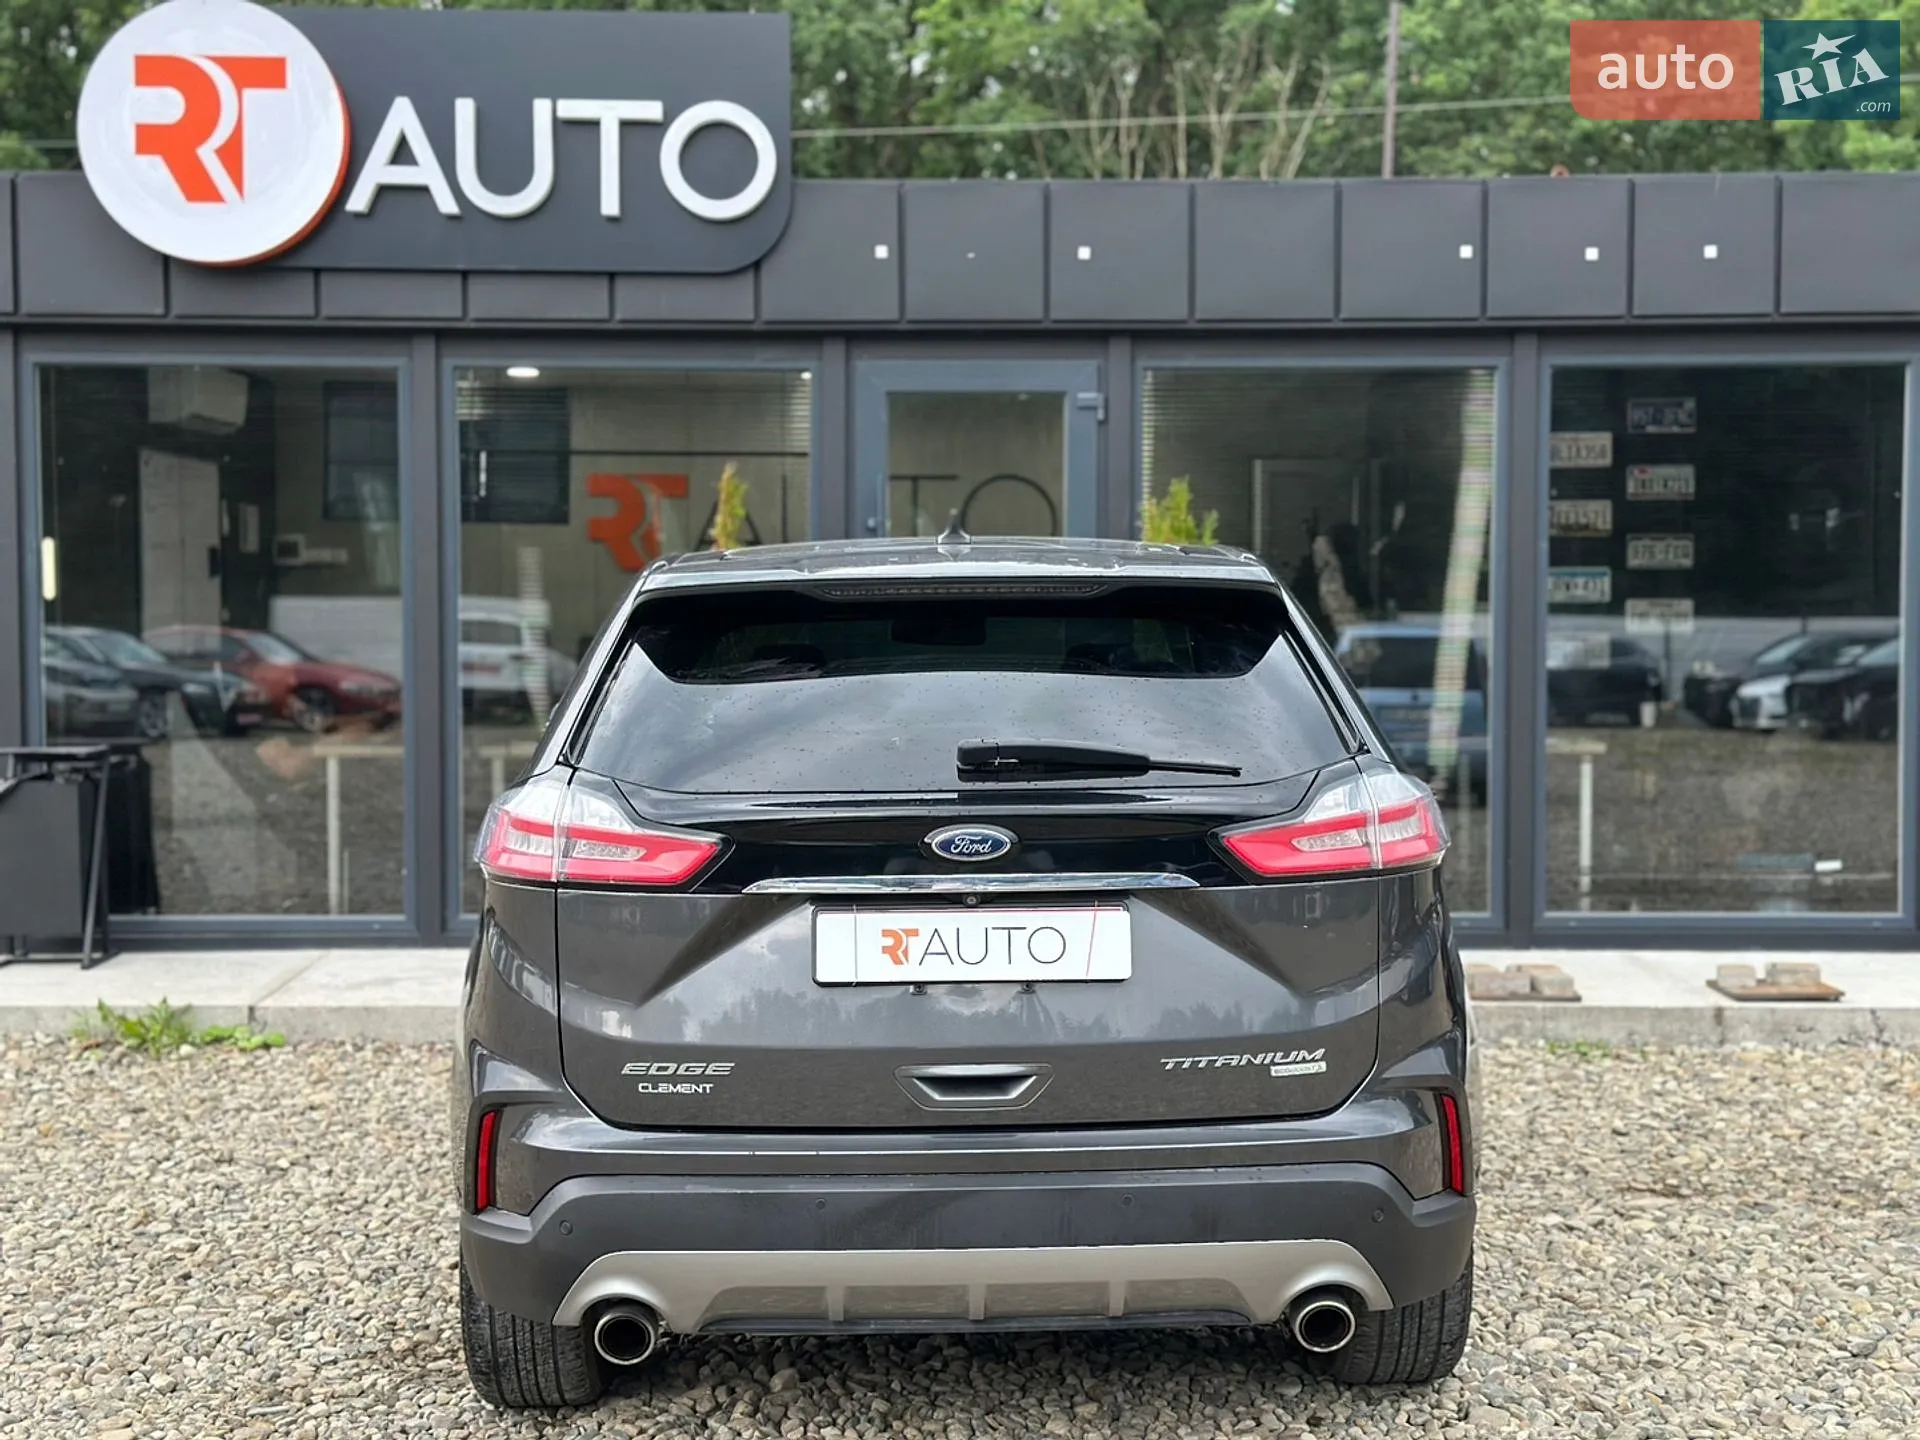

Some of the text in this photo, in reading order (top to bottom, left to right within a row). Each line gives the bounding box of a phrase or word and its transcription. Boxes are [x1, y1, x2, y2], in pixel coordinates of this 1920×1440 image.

[133, 53, 778, 222] RT AUTO
[949, 835, 993, 855] Ford
[918, 926, 1067, 967] AUTO
[620, 1062, 736, 1076] EDGE
[1159, 1047, 1327, 1071] TITANIUM
[638, 1082, 715, 1094] CLEMENT
